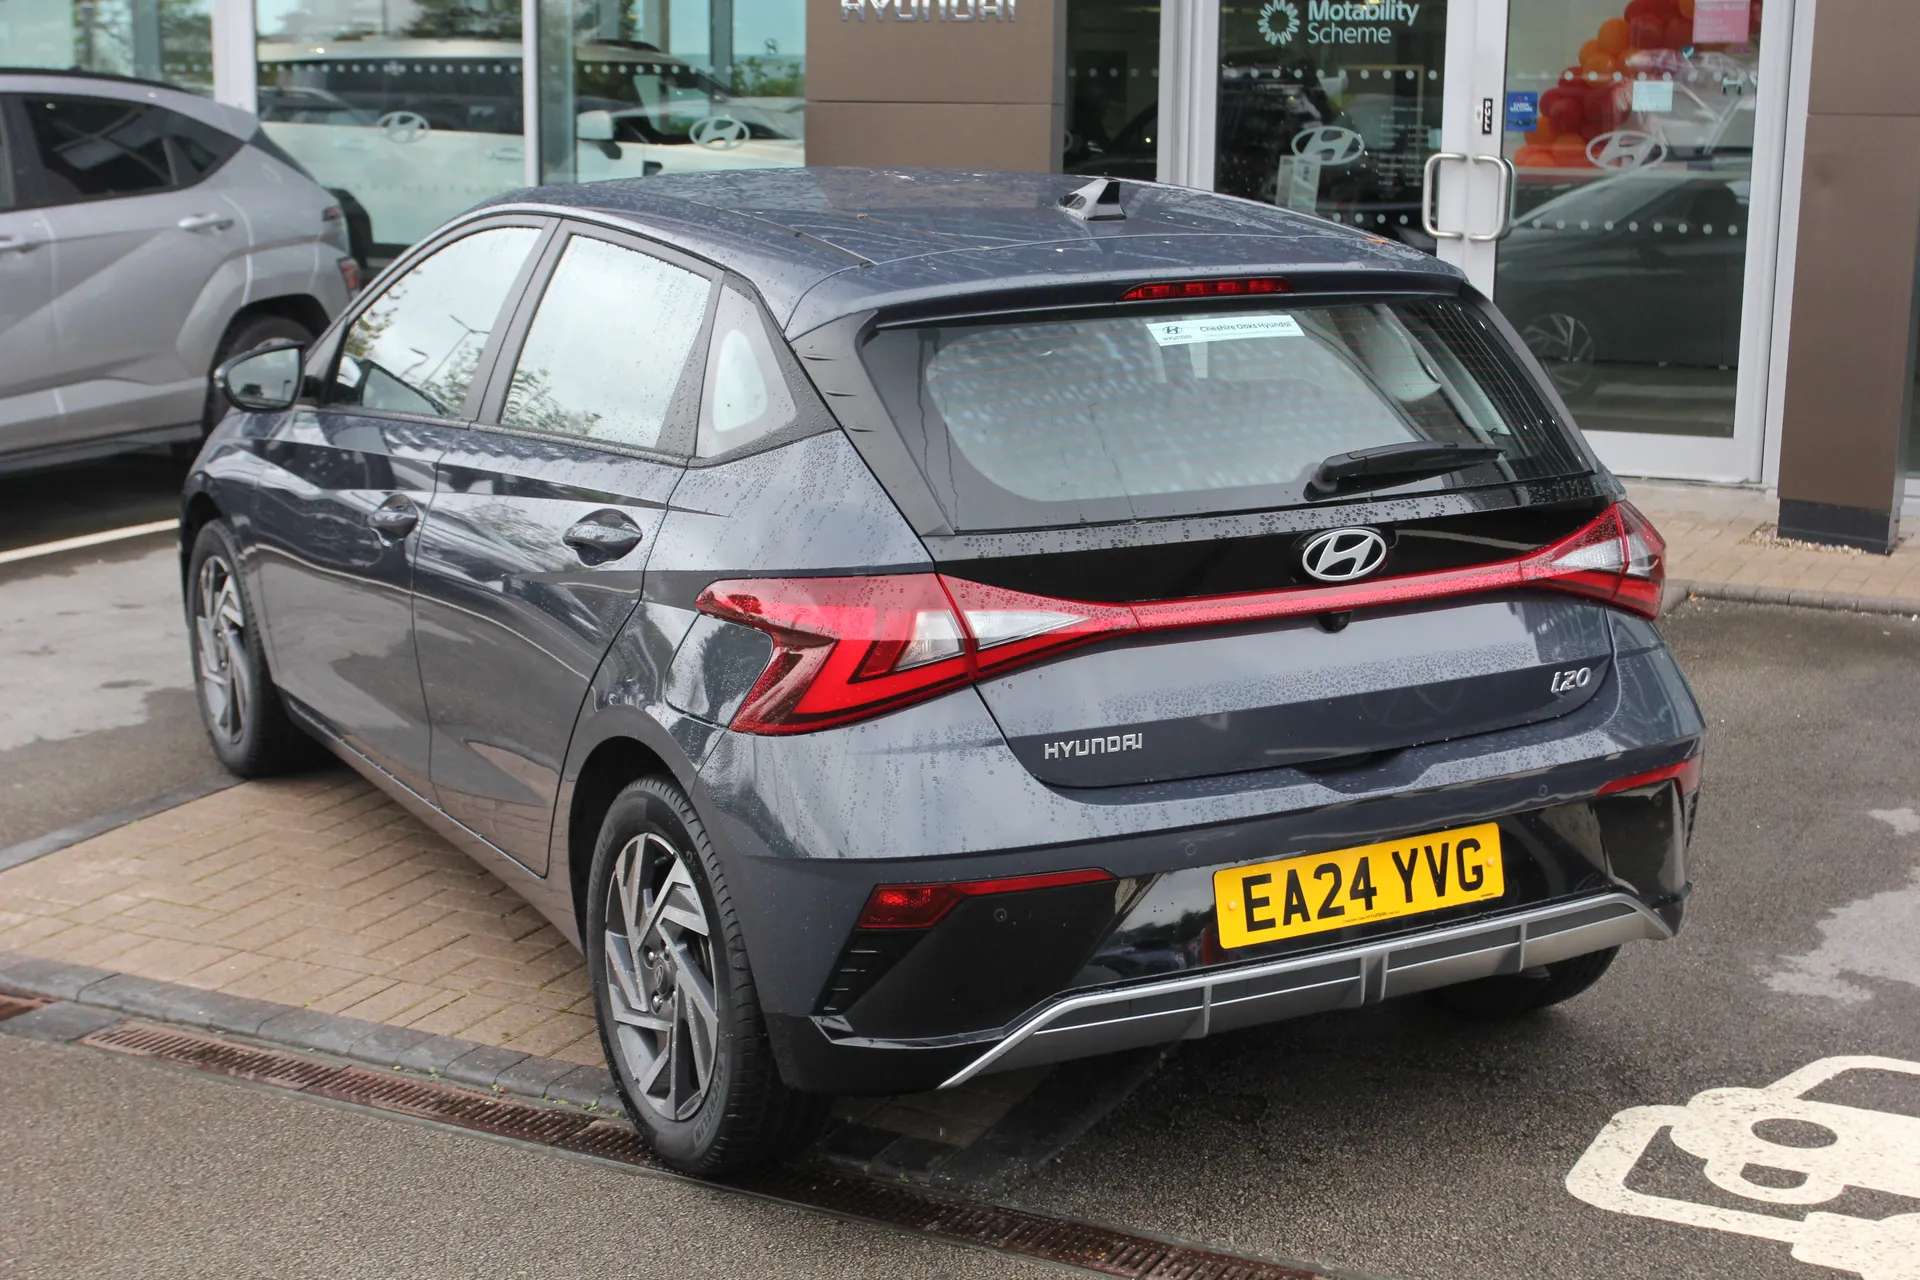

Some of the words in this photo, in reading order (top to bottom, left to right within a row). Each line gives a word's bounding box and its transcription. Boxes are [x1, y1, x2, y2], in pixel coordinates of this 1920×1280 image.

[840, 0, 1016, 22] HYUNDAI
[1308, 0, 1420, 27] Motability
[1307, 23, 1392, 44] Scheme
[1484, 100, 1492, 132] PULL
[1200, 324, 1236, 333] Cheshire
[1258, 321, 1292, 330] Hyundai
[1044, 733, 1143, 760] HYUNDAI
[1241, 856, 1378, 933] EA24
[1391, 838, 1484, 904] YVG
